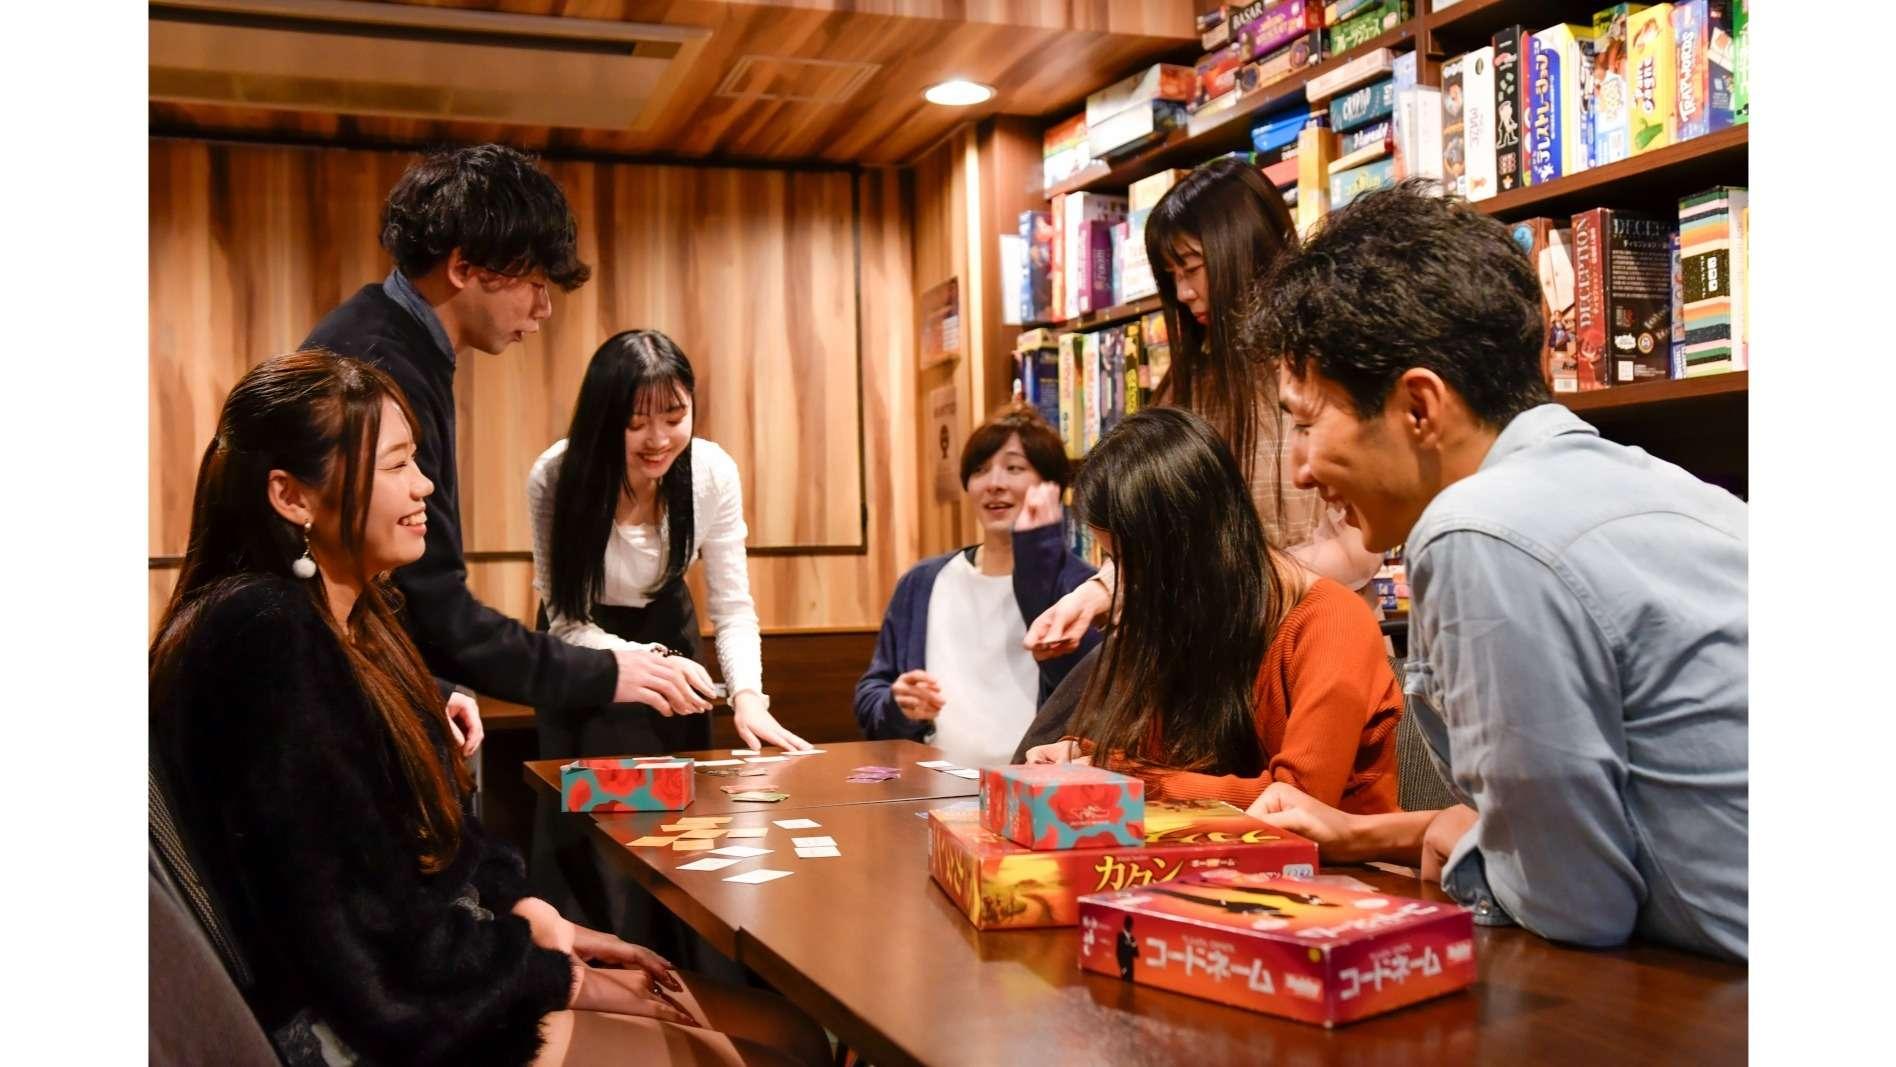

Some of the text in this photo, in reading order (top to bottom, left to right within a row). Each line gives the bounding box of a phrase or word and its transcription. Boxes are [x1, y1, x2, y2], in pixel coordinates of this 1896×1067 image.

[1576, 218, 1592, 328] DECEPTION
[1145, 937, 1276, 995] コードネーム
[1338, 945, 1443, 1000] コードネーム
